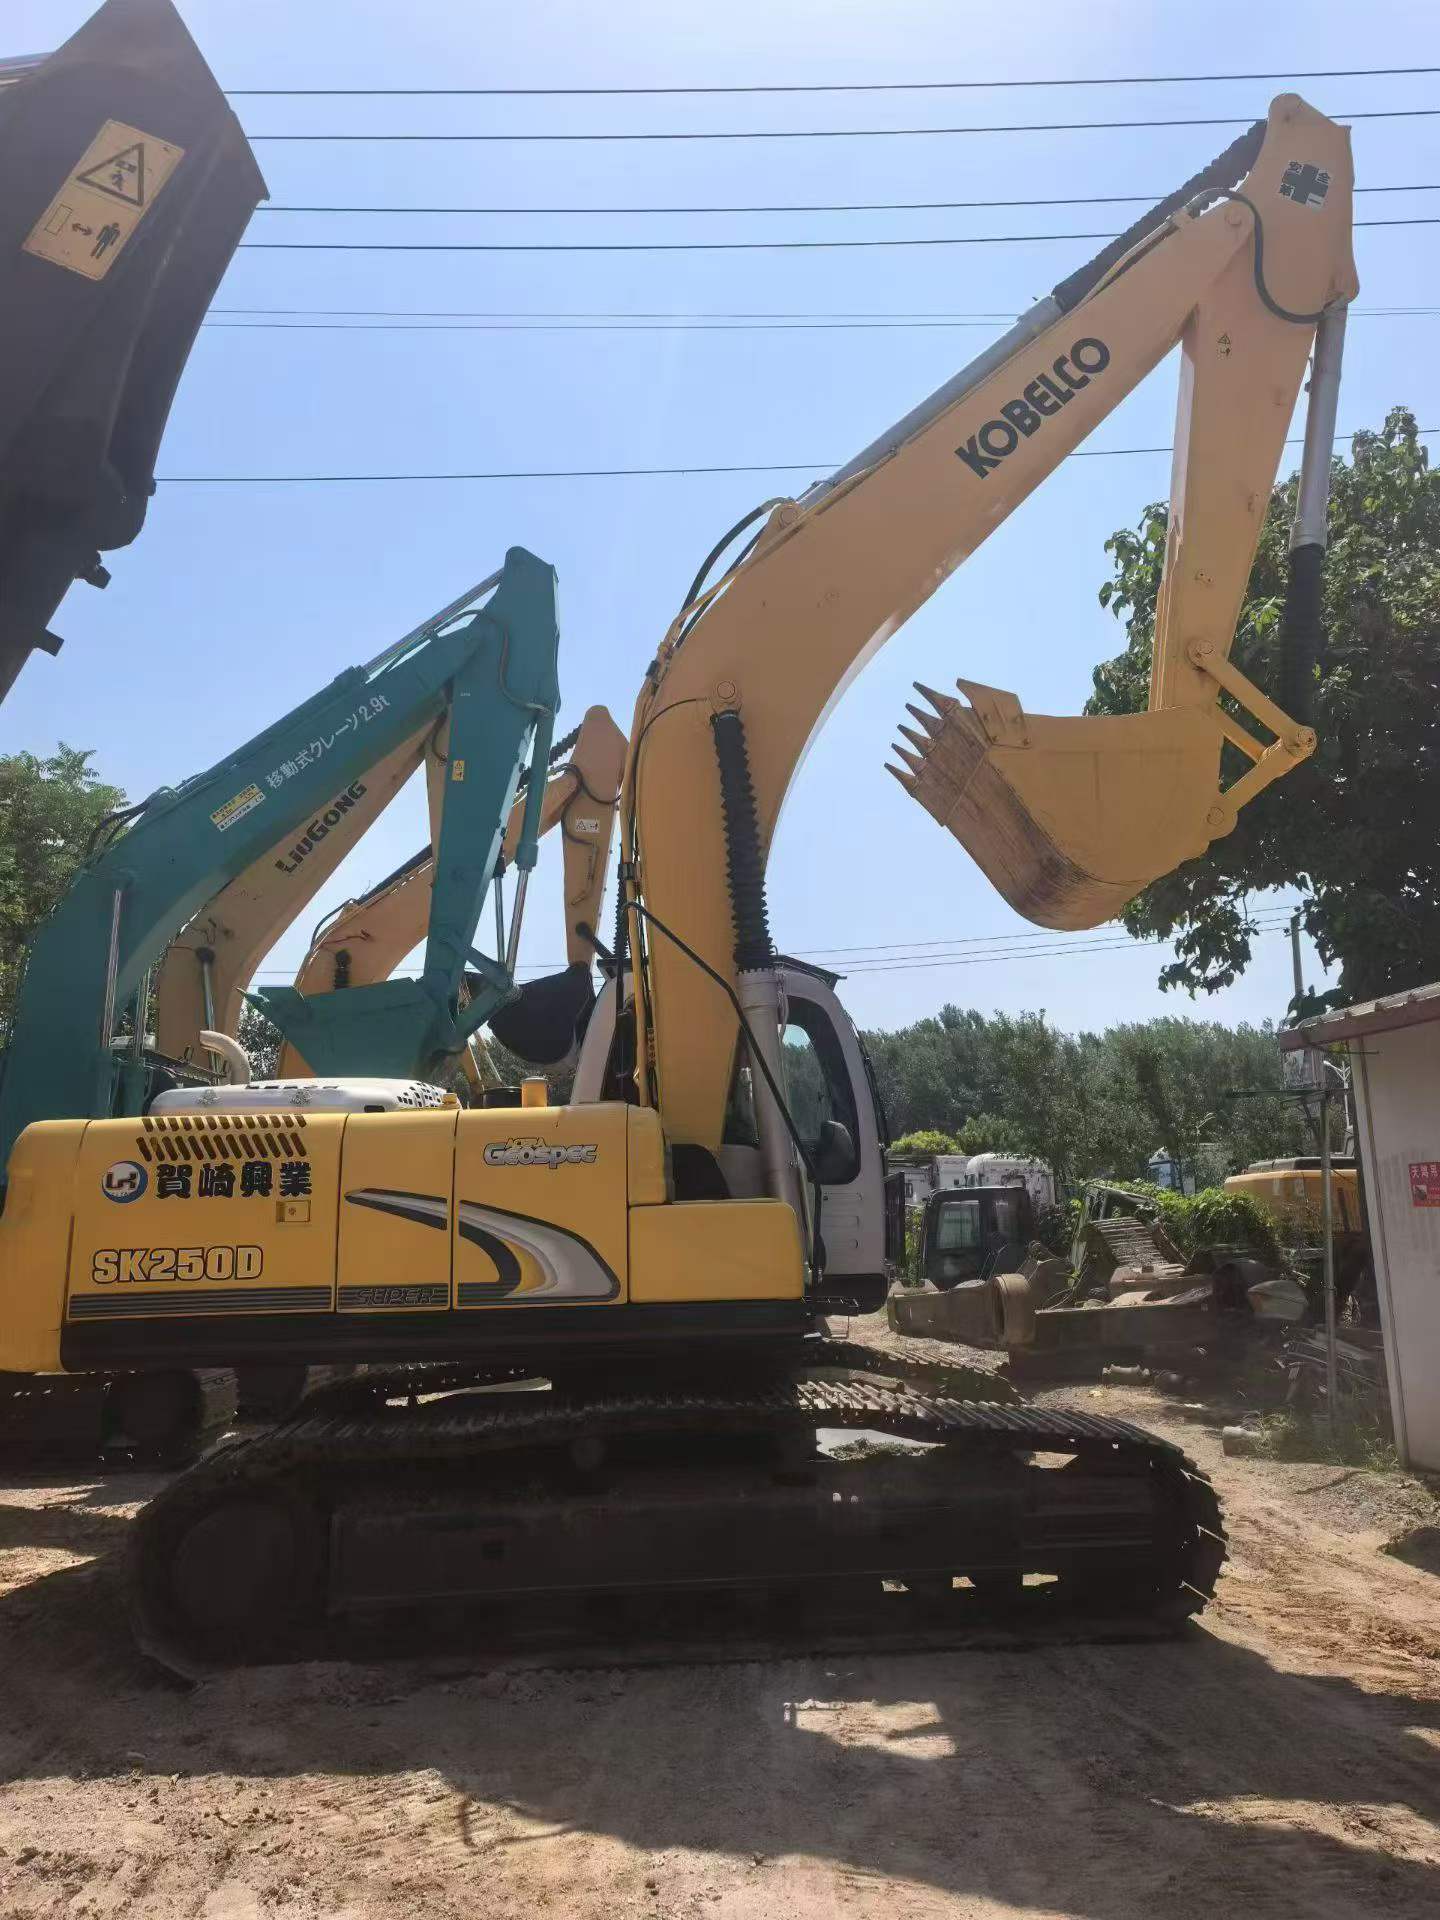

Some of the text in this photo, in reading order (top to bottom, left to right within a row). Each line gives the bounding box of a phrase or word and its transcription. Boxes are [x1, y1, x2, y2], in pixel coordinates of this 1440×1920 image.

[954, 337, 1111, 480] KOBELCO
[274, 780, 368, 873] LIUGONG
[93, 1245, 263, 1284] SK250D
